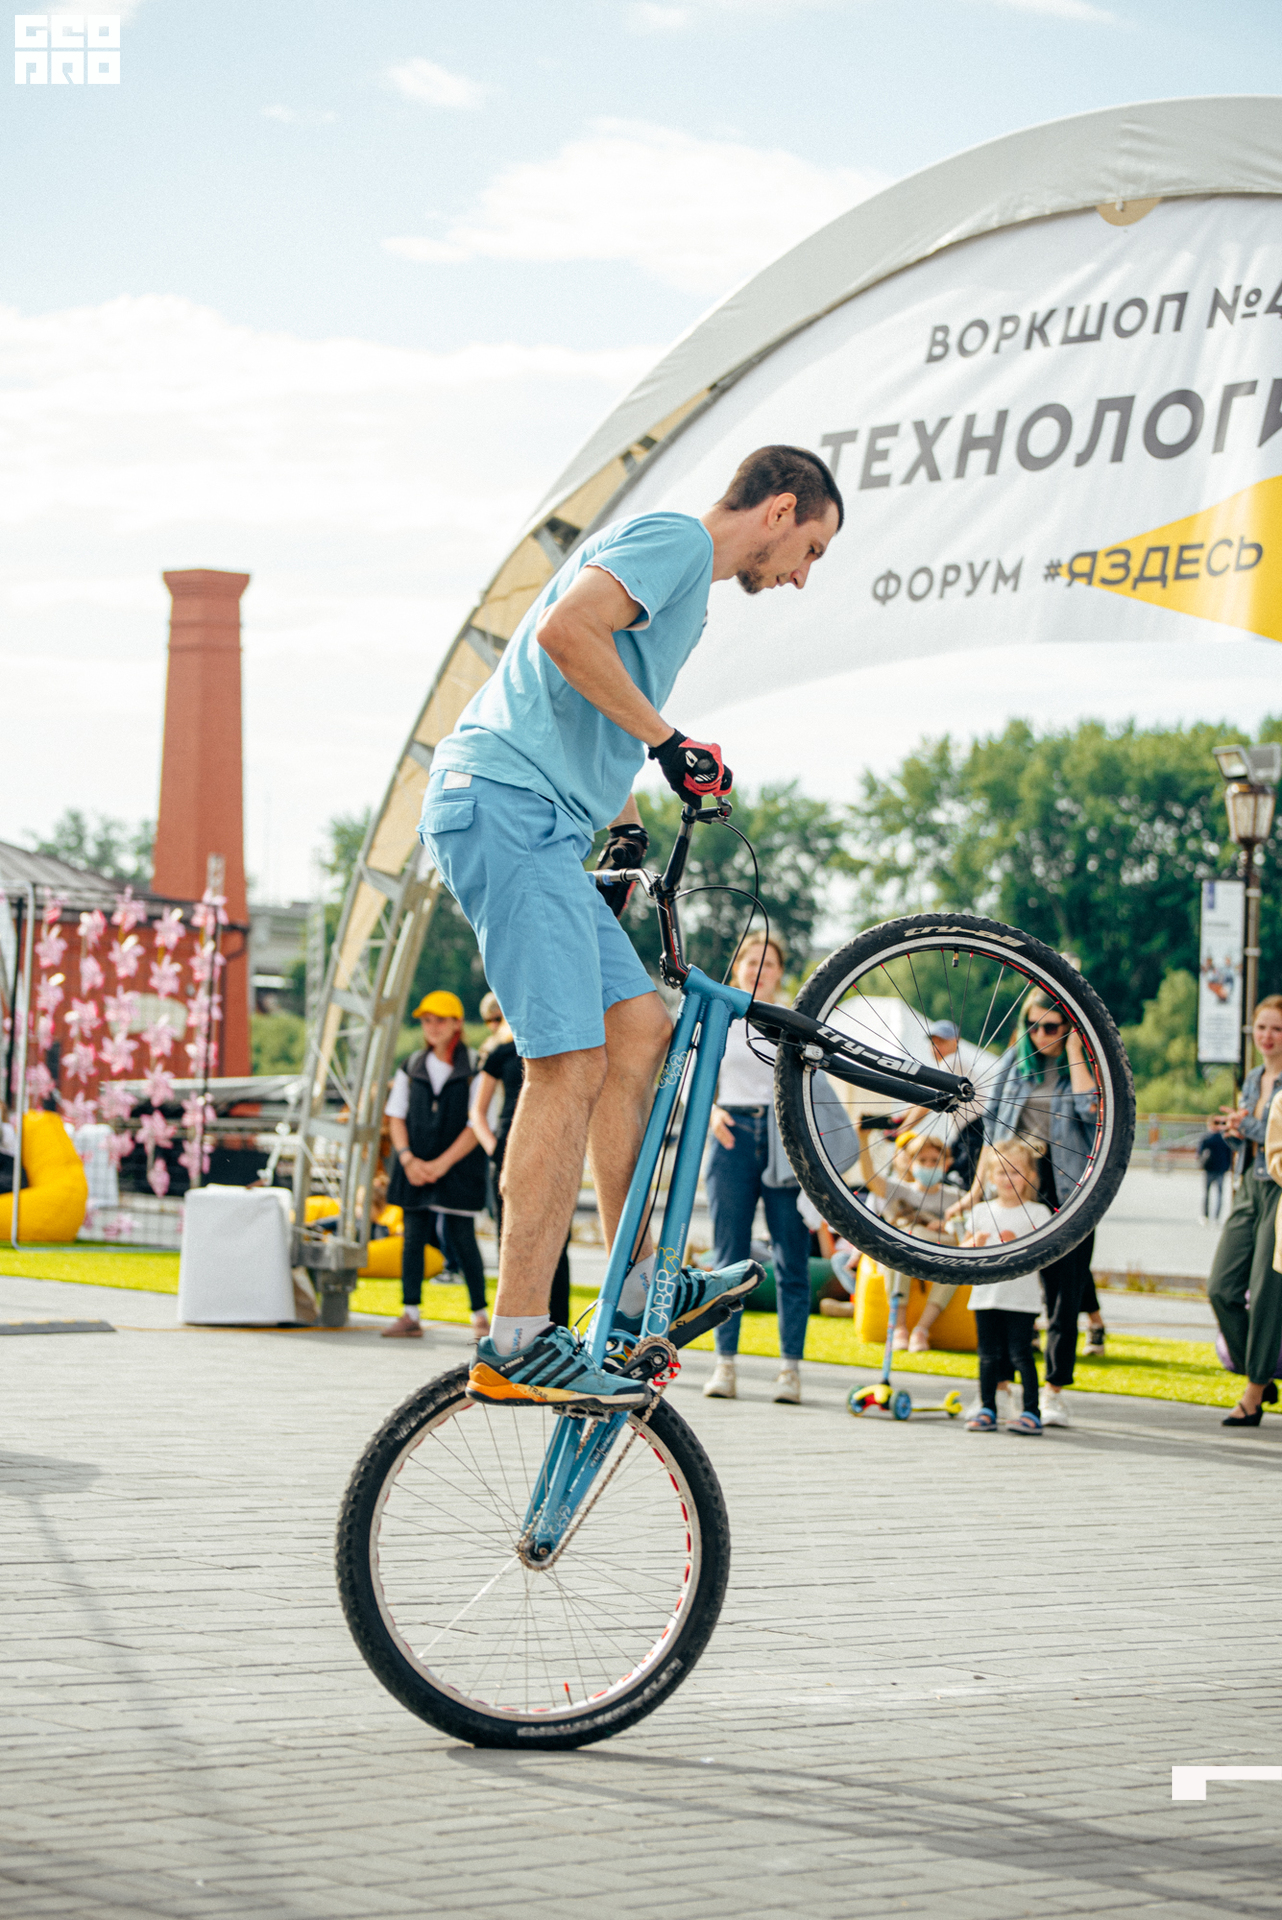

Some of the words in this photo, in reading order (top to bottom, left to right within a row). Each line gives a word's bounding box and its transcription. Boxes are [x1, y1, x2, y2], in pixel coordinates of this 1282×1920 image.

[925, 291, 1189, 363] ВОРКШОП
[871, 556, 1024, 605] ФОРУМ
[1043, 536, 1263, 590] #ЯЗДЕСЬ
[904, 926, 1026, 947] try-all
[816, 1025, 921, 1075] try-all
